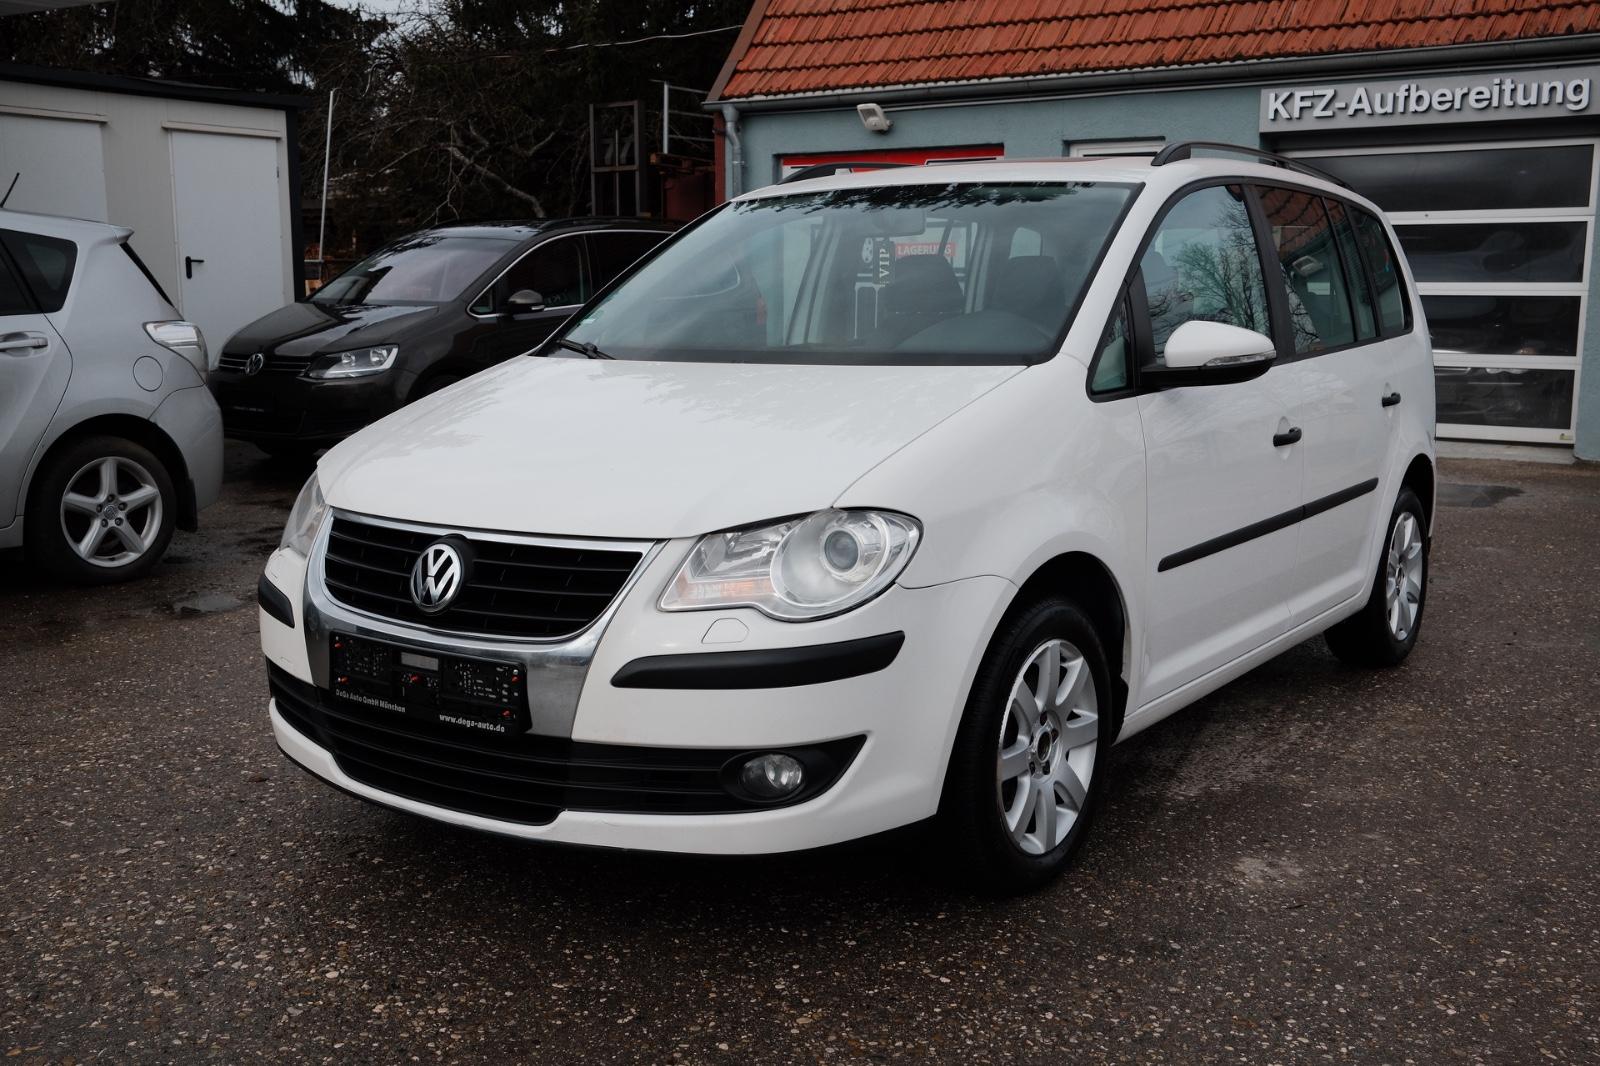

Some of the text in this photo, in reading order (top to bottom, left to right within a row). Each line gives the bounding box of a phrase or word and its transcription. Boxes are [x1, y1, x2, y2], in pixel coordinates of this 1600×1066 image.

[1267, 78, 1591, 120] KFZ-Aufbereitung
[879, 247, 890, 278] VIP
[411, 543, 461, 613] VW
[350, 692, 362, 703] Auto
[362, 695, 379, 707] GmbH
[380, 699, 406, 713] München
[439, 714, 505, 733] www.doga-auto.de
